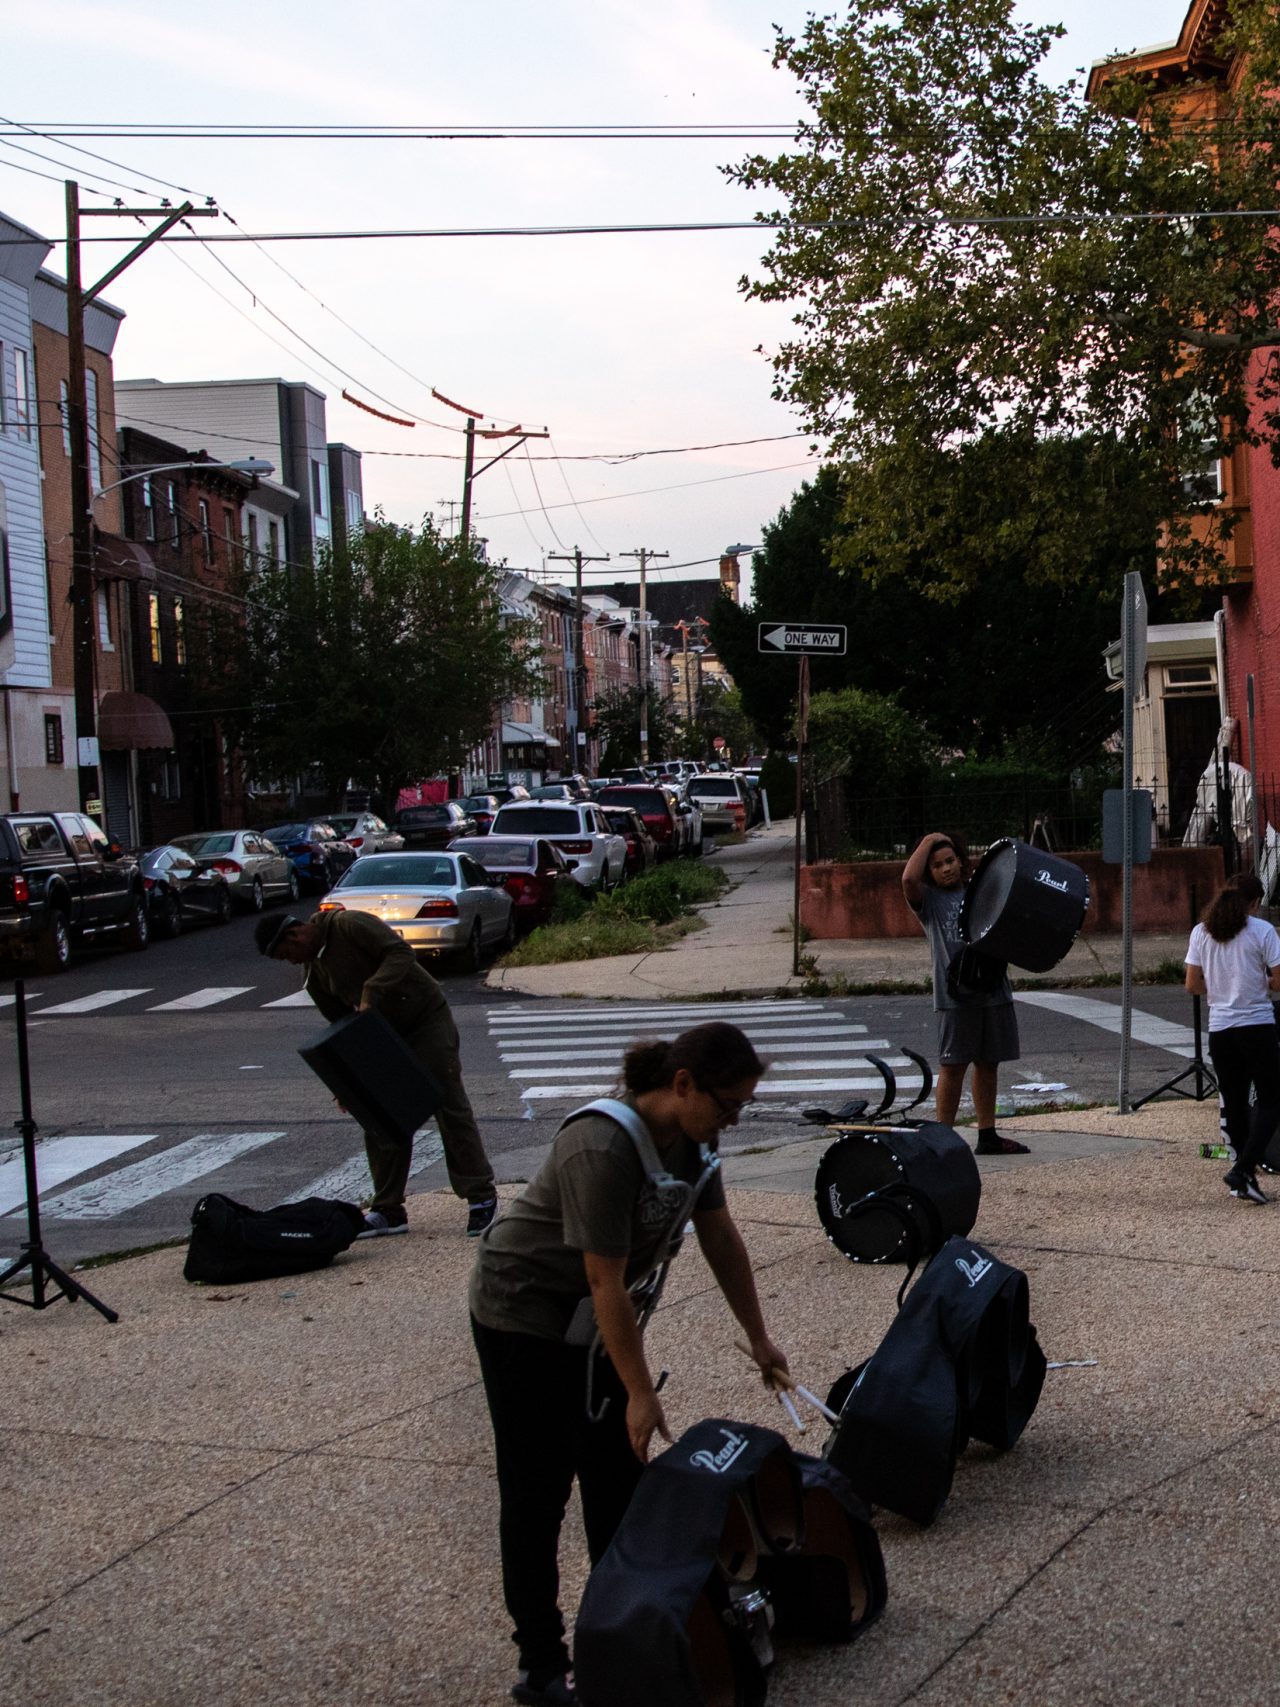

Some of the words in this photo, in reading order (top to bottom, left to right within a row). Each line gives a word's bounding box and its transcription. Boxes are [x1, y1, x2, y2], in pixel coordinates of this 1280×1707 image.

[784, 632, 808, 645] ONE
[812, 633, 836, 645] WAY
[1034, 869, 1069, 892] Pearl
[689, 1428, 746, 1473] Pearl
